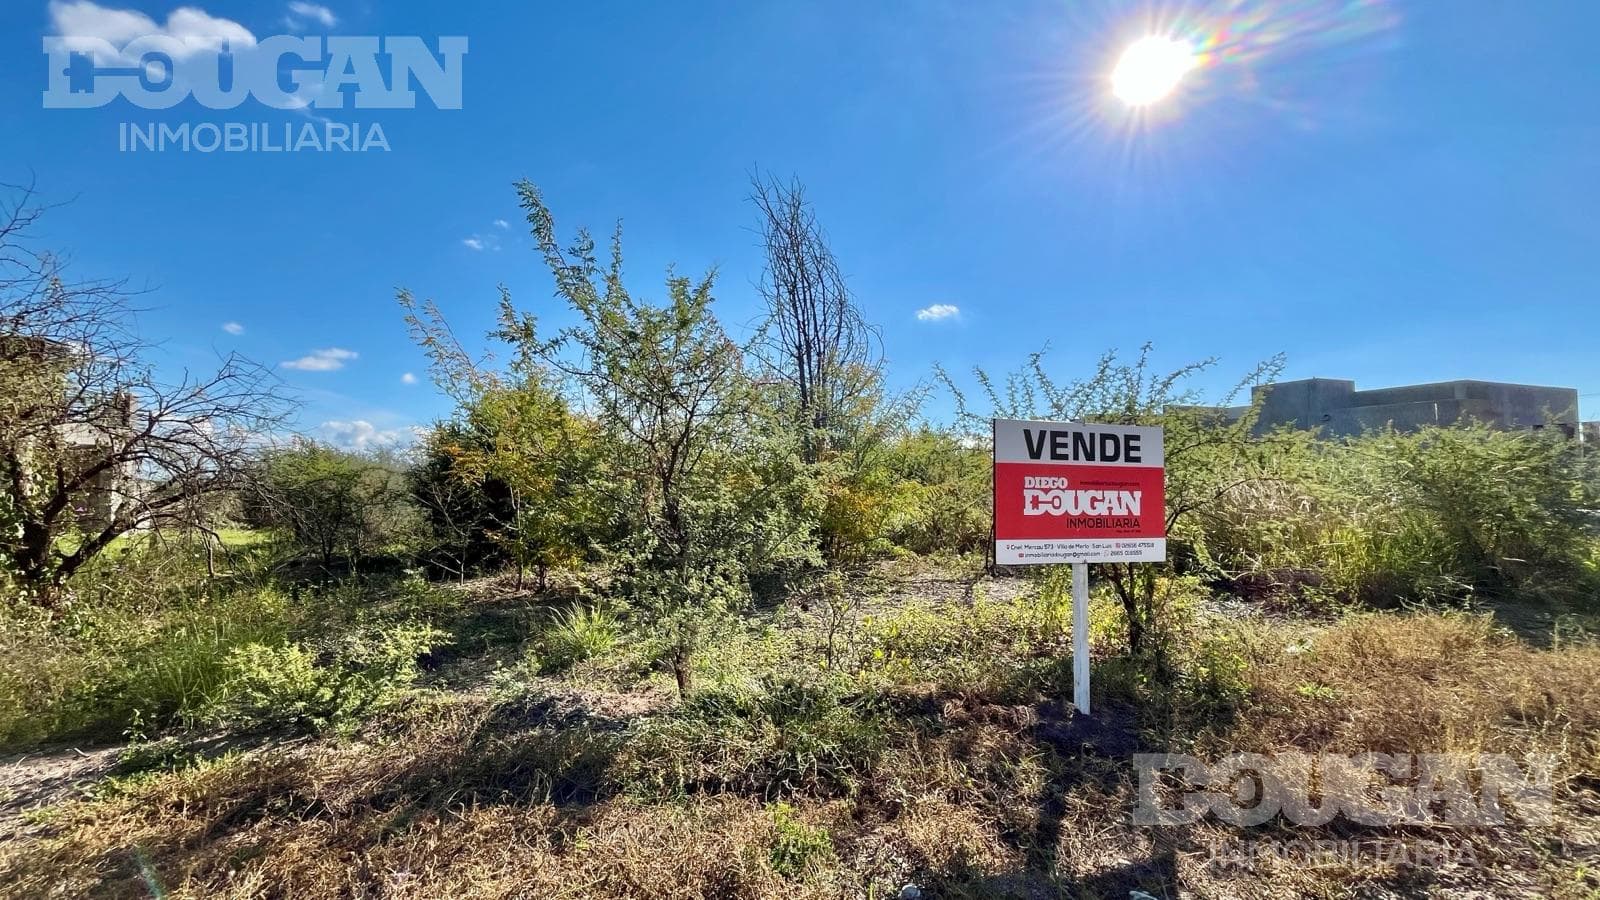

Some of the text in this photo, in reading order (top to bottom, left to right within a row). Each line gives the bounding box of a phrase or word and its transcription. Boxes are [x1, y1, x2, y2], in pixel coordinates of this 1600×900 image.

[1023, 428, 1142, 463] VENDE
[1024, 476, 1068, 489] DIEGO
[1023, 489, 1142, 516] DOUGAN
[1066, 517, 1141, 529] INMOBILIARIA
